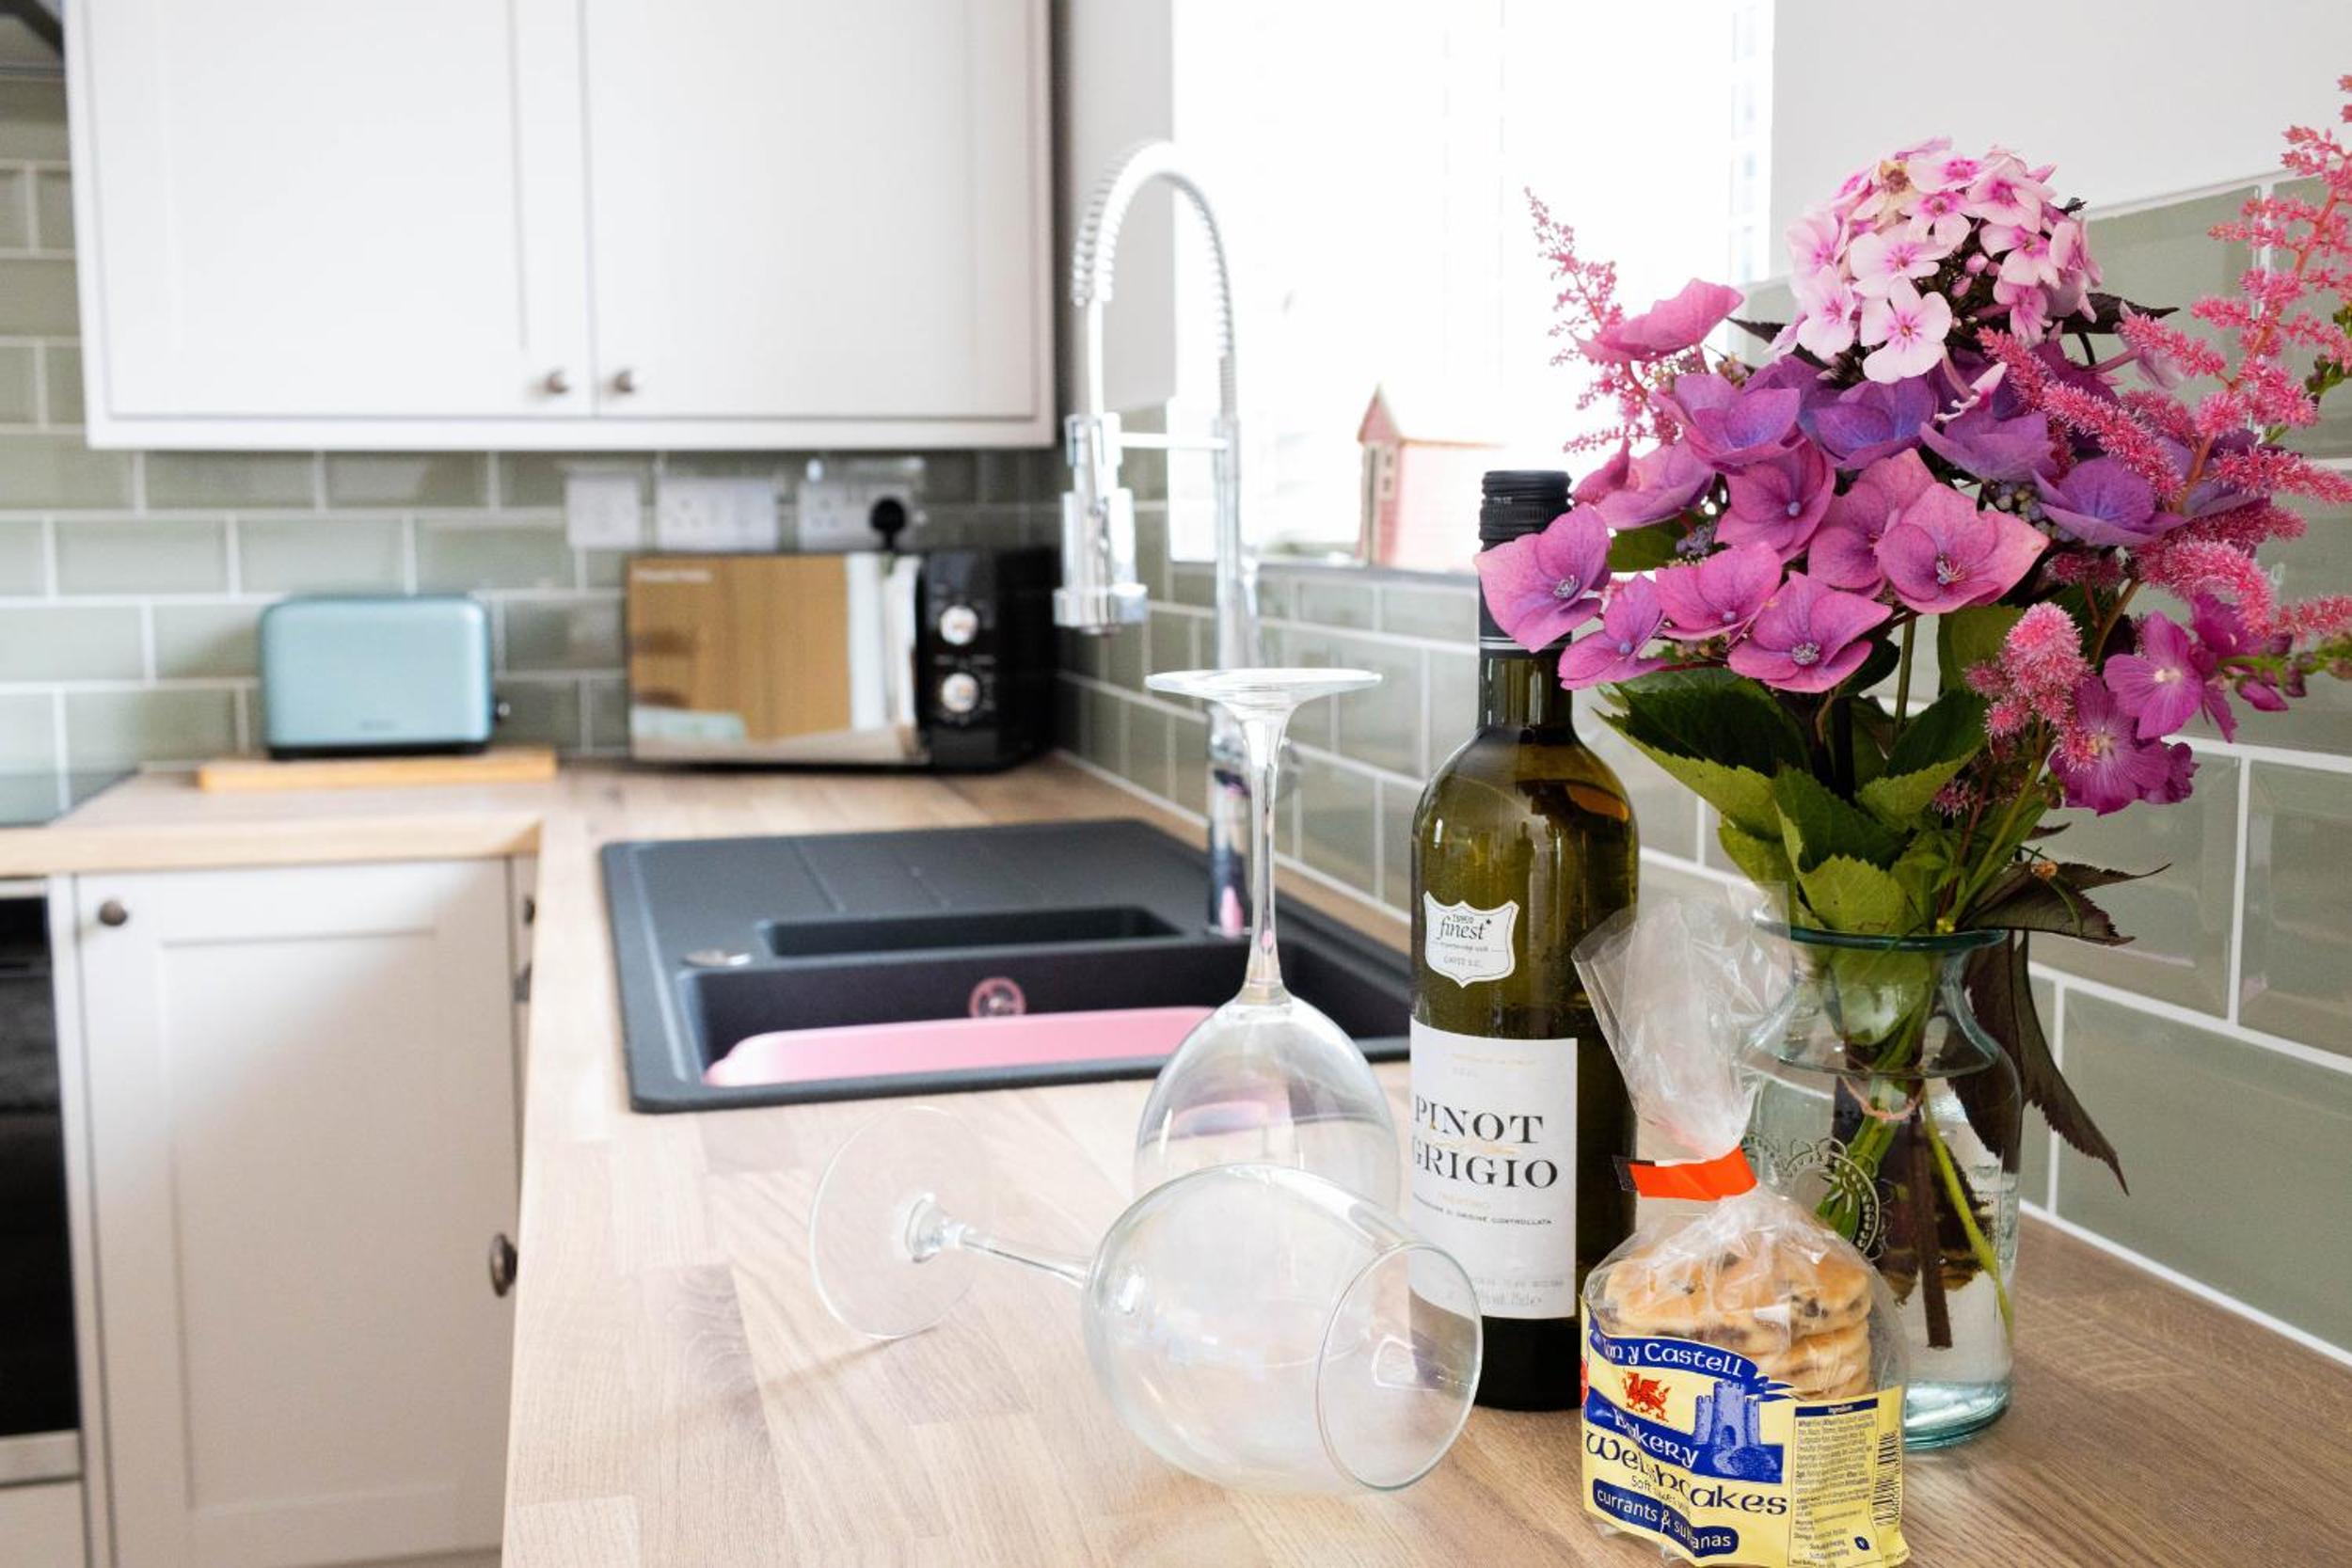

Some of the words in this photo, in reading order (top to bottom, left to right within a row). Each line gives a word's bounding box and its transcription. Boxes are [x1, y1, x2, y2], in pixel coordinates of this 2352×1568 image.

[1437, 915, 1486, 940] finest
[1415, 1094, 1543, 1144] PINOT
[1413, 1135, 1558, 1189] GRIGIO
[1644, 1343, 1742, 1378] Castell
[1597, 1490, 1659, 1522] currants
[1661, 1510, 1671, 1528] &
[1674, 1520, 1731, 1549] sulanas
